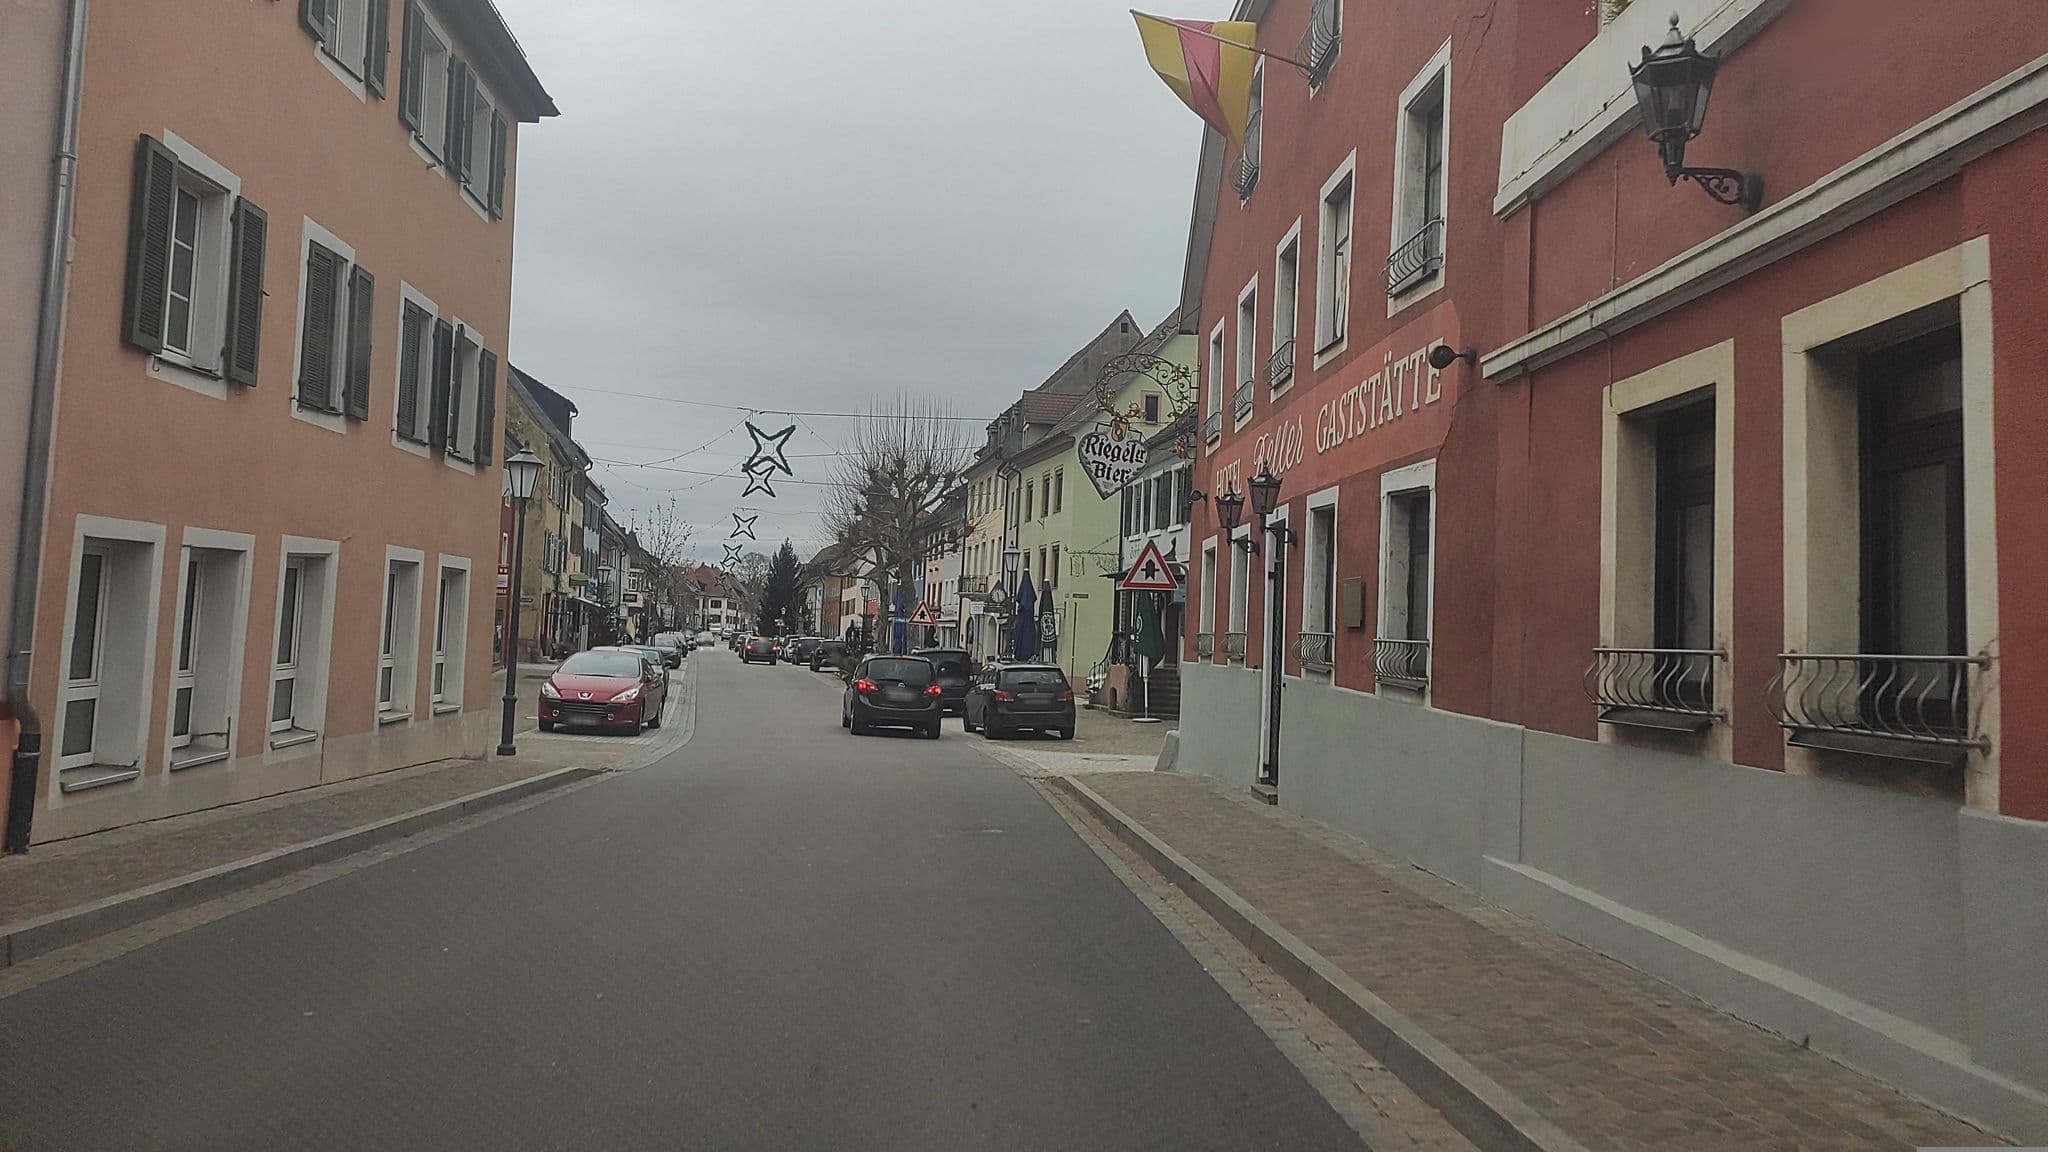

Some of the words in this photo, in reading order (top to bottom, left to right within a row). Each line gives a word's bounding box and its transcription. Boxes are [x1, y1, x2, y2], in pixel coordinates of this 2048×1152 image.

[1216, 458, 1242, 498] HOTEL
[1254, 413, 1304, 479] Keller
[1315, 336, 1444, 454] GASTSTÄTTE
[1091, 460, 1132, 483] Bier
